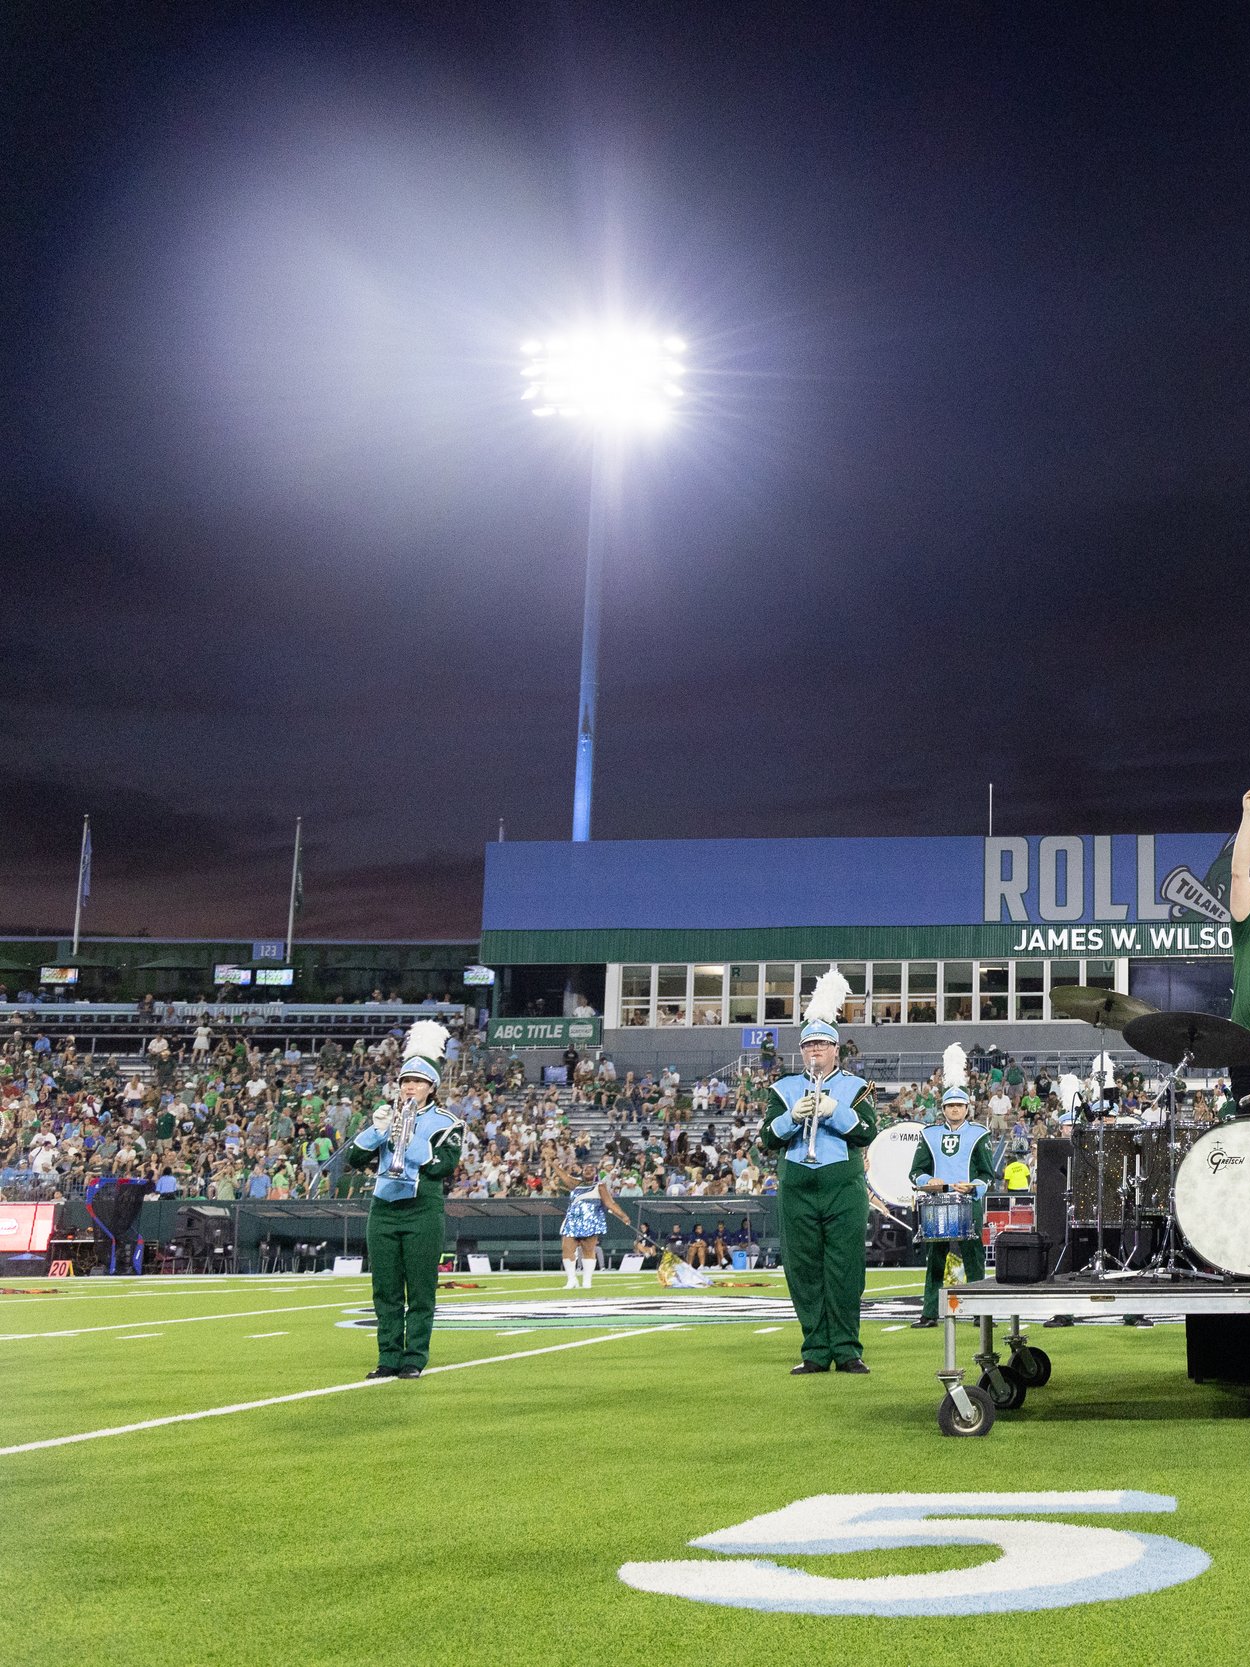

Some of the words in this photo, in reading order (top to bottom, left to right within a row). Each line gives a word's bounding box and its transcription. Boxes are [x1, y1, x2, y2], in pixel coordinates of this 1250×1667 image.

[983, 835, 1172, 922] ROLL
[1175, 877, 1226, 920] TULANE
[1014, 928, 1104, 951] JAMES
[1110, 927, 1142, 951] W.
[1150, 927, 1234, 951] WILSO
[259, 944, 277, 957] 123
[493, 1024, 523, 1039] ABC
[526, 1024, 564, 1039] TITLE
[899, 1133, 922, 1142] YAMA
[50, 1262, 67, 1276] 20
